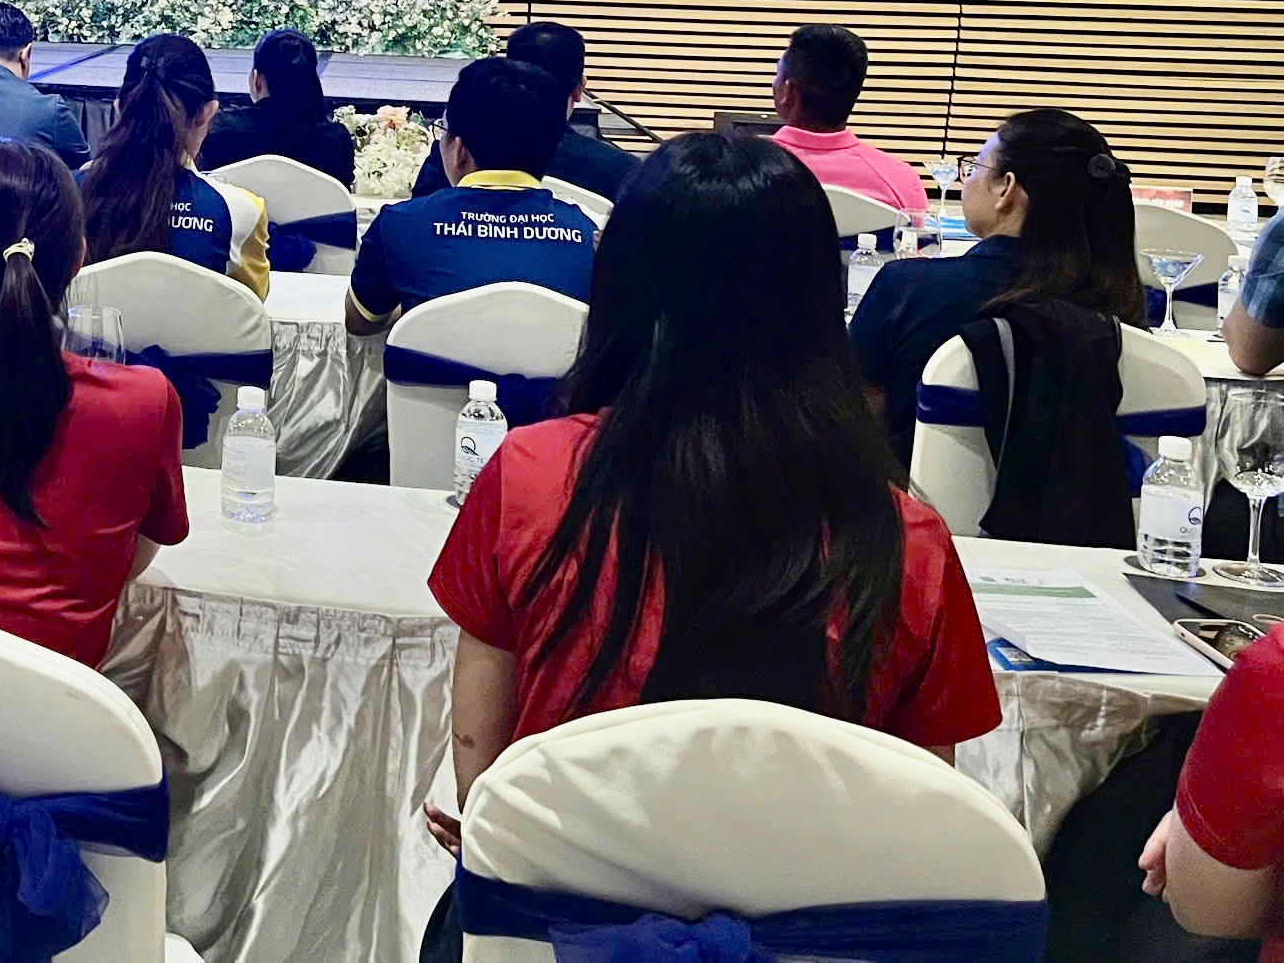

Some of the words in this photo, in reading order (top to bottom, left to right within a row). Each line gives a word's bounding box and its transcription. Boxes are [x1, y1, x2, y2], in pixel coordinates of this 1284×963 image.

[169, 216, 214, 233] ƯƠNG
[509, 214, 529, 225] ĐẠI
[531, 213, 555, 224] HỌC
[433, 220, 472, 237] THÁI
[477, 223, 519, 239] BÌNH
[523, 226, 583, 243] DƯƠNG
